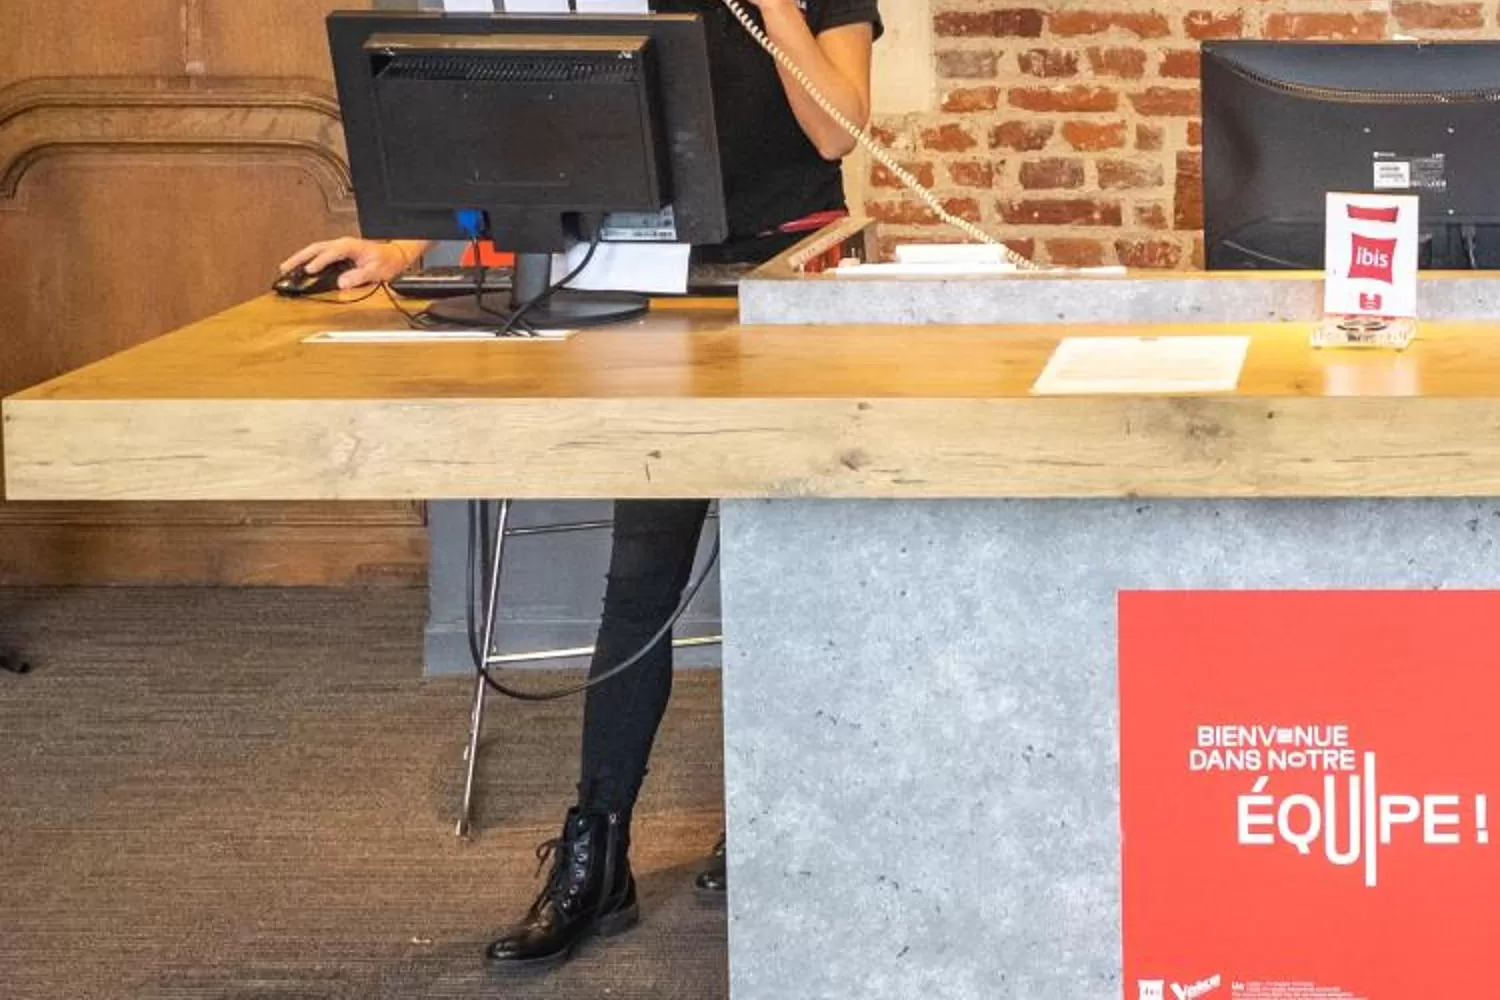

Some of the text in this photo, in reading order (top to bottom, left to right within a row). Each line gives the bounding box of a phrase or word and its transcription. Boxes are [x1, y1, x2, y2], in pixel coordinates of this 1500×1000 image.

[1355, 246, 1389, 267] ibis
[1197, 725, 1348, 747] BIENVENUE
[1189, 750, 1355, 771] DANS NOTRE
